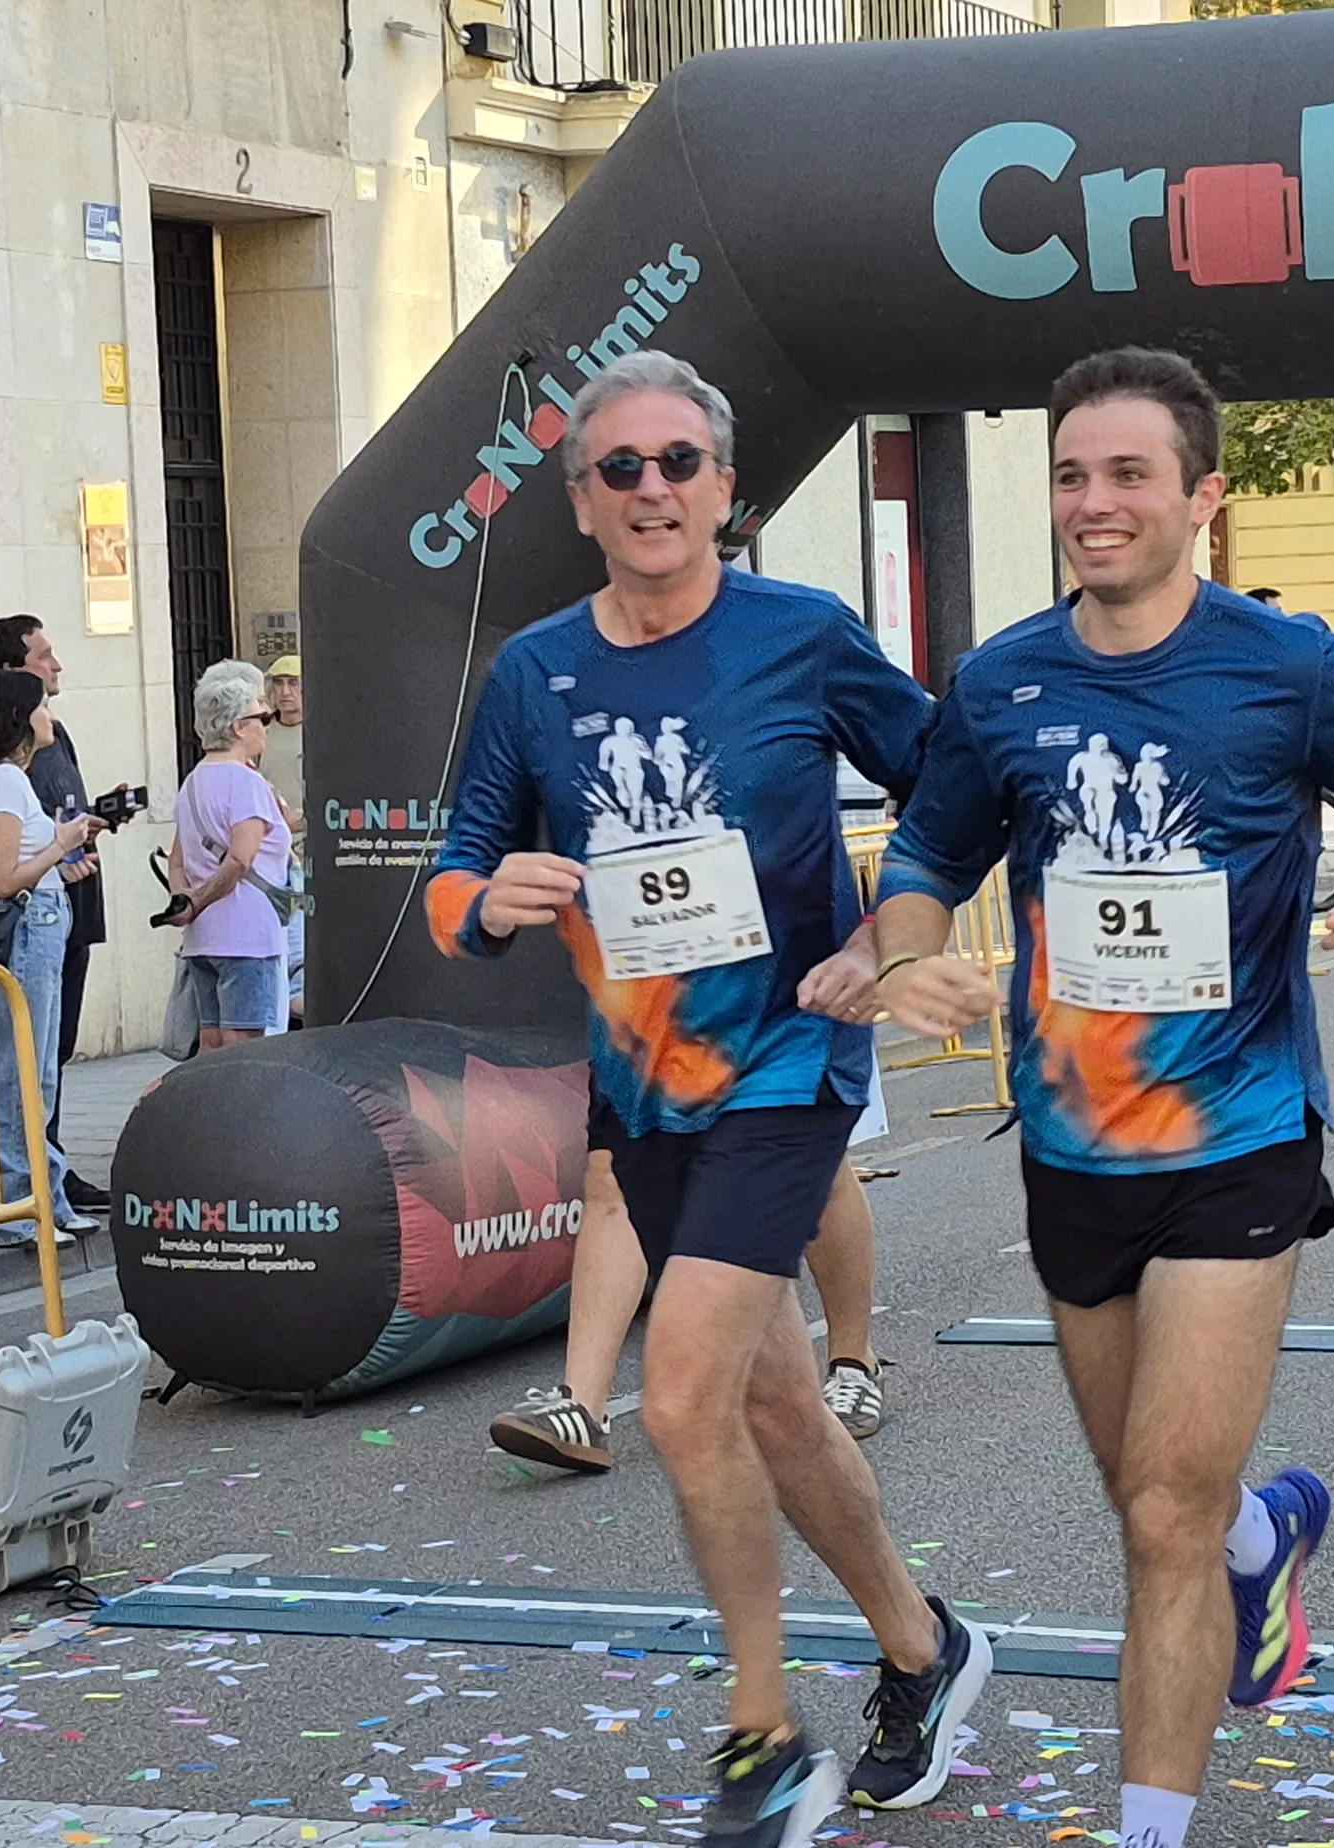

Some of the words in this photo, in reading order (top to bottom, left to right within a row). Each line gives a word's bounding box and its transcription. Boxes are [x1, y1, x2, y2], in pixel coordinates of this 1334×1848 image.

[235, 147, 254, 195] 2
[639, 866, 691, 906] 89
[1097, 899, 1163, 938] 91
[1093, 942, 1171, 960] VICENTE
[203, 1239, 219, 1254] de
[274, 1242, 286, 1257] y
[453, 1198, 585, 1260] www.cro
[247, 1257, 317, 1275] deportivo
